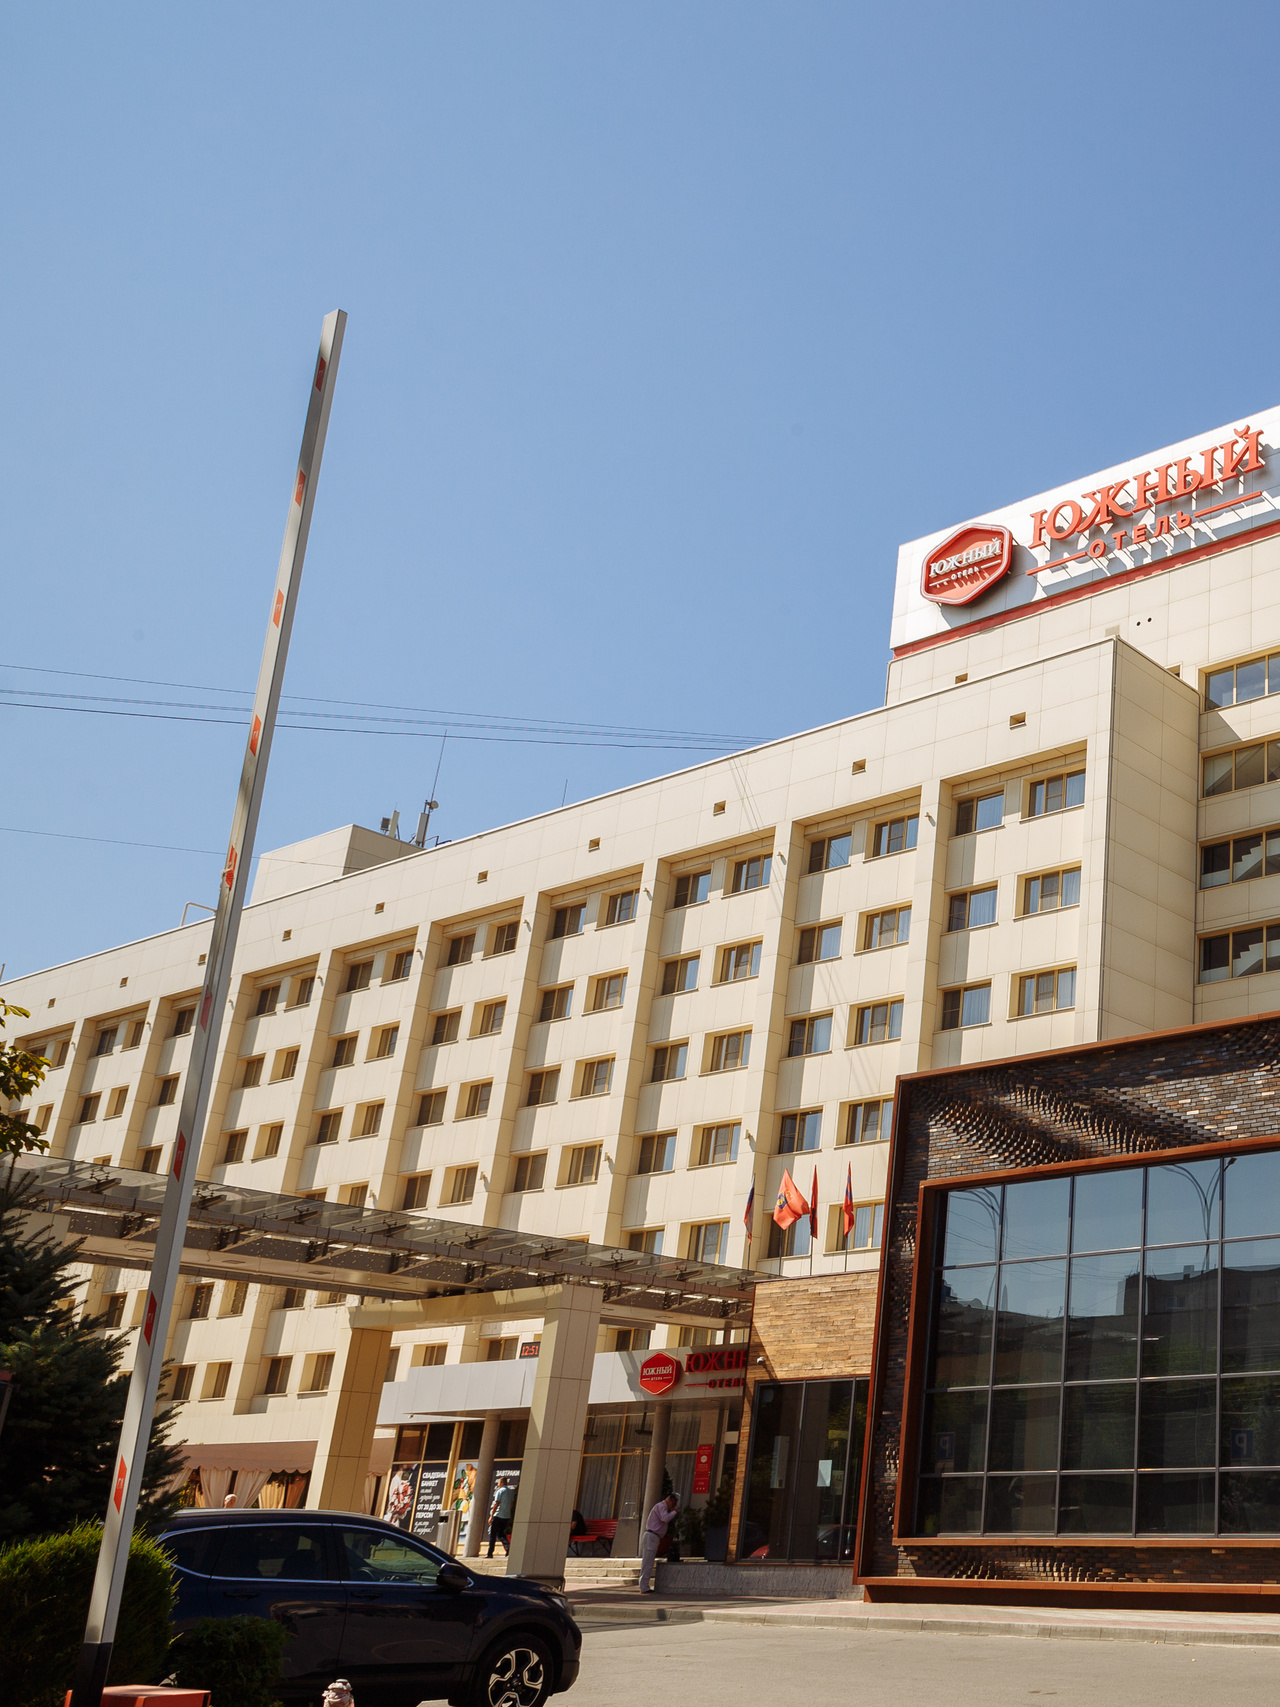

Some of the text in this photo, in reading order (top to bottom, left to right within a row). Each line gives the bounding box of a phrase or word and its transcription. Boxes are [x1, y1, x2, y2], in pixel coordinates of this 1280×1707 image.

[1028, 425, 1264, 549] ЮЖНЫЙ
[1089, 510, 1192, 558] ОТЕЛЬ
[929, 537, 1002, 578] ЮЖНЫЙ
[951, 566, 980, 580] ОТЕЛЬ
[521, 1345, 539, 1356] 12:51
[642, 1364, 672, 1376] ЮЖНЫЙ
[684, 1350, 748, 1373] ЮЖН
[422, 1471, 447, 1479] СВАДЕБНЫ
